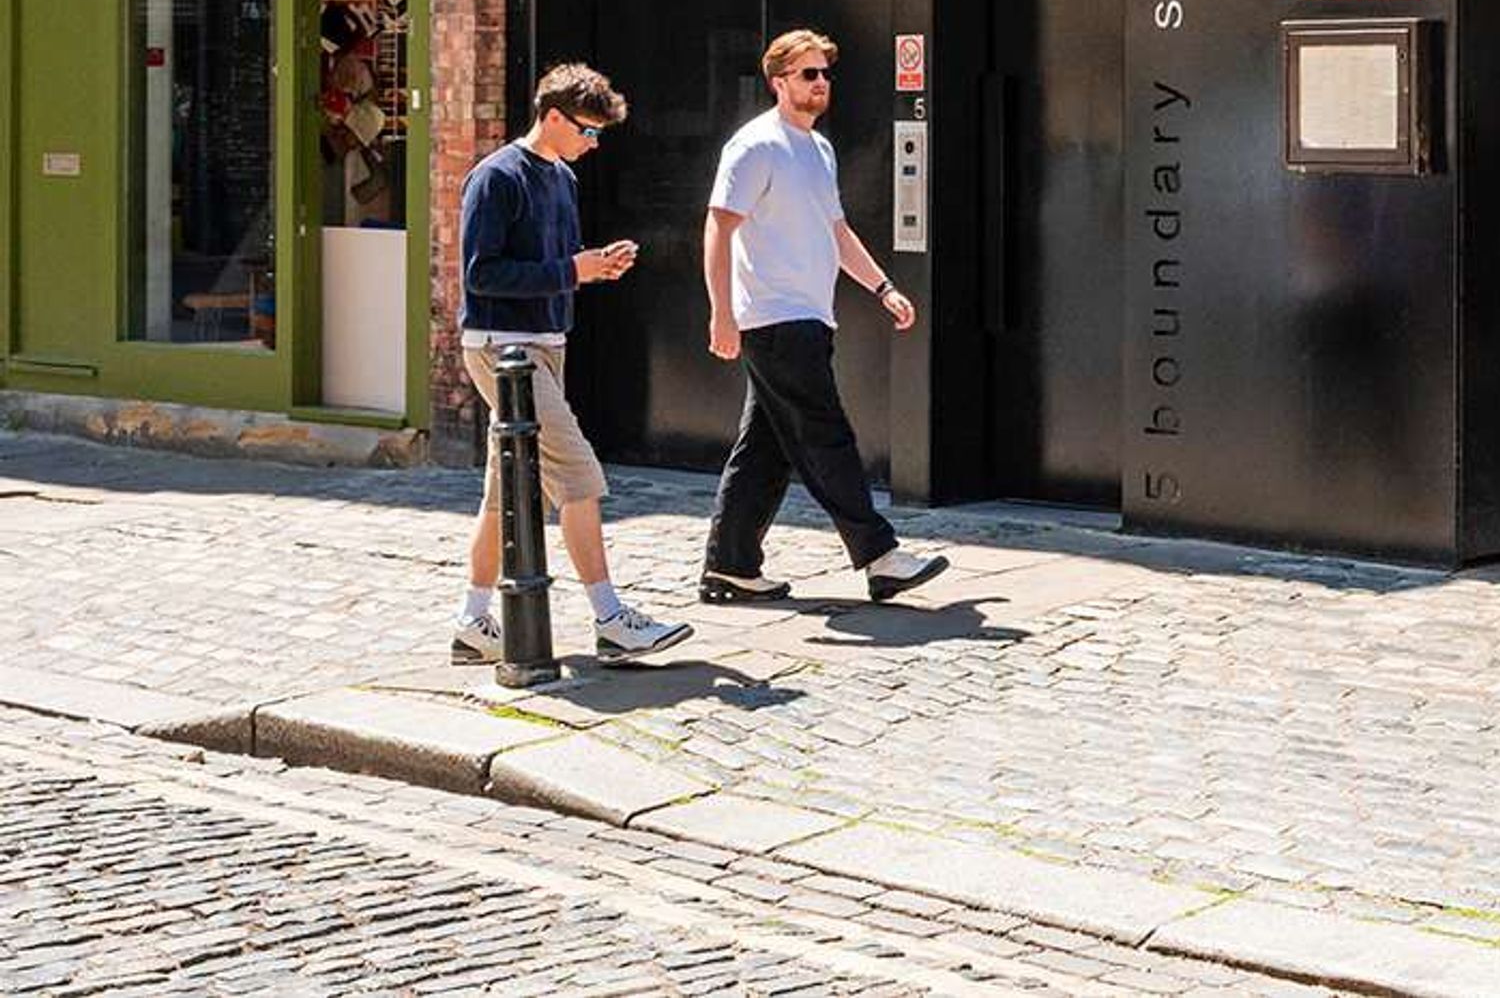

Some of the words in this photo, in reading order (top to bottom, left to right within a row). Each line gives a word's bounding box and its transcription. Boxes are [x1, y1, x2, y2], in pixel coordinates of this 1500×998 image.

[913, 98, 926, 120] 5
[1144, 80, 1192, 436] boundary
[1144, 470, 1182, 504] 5
